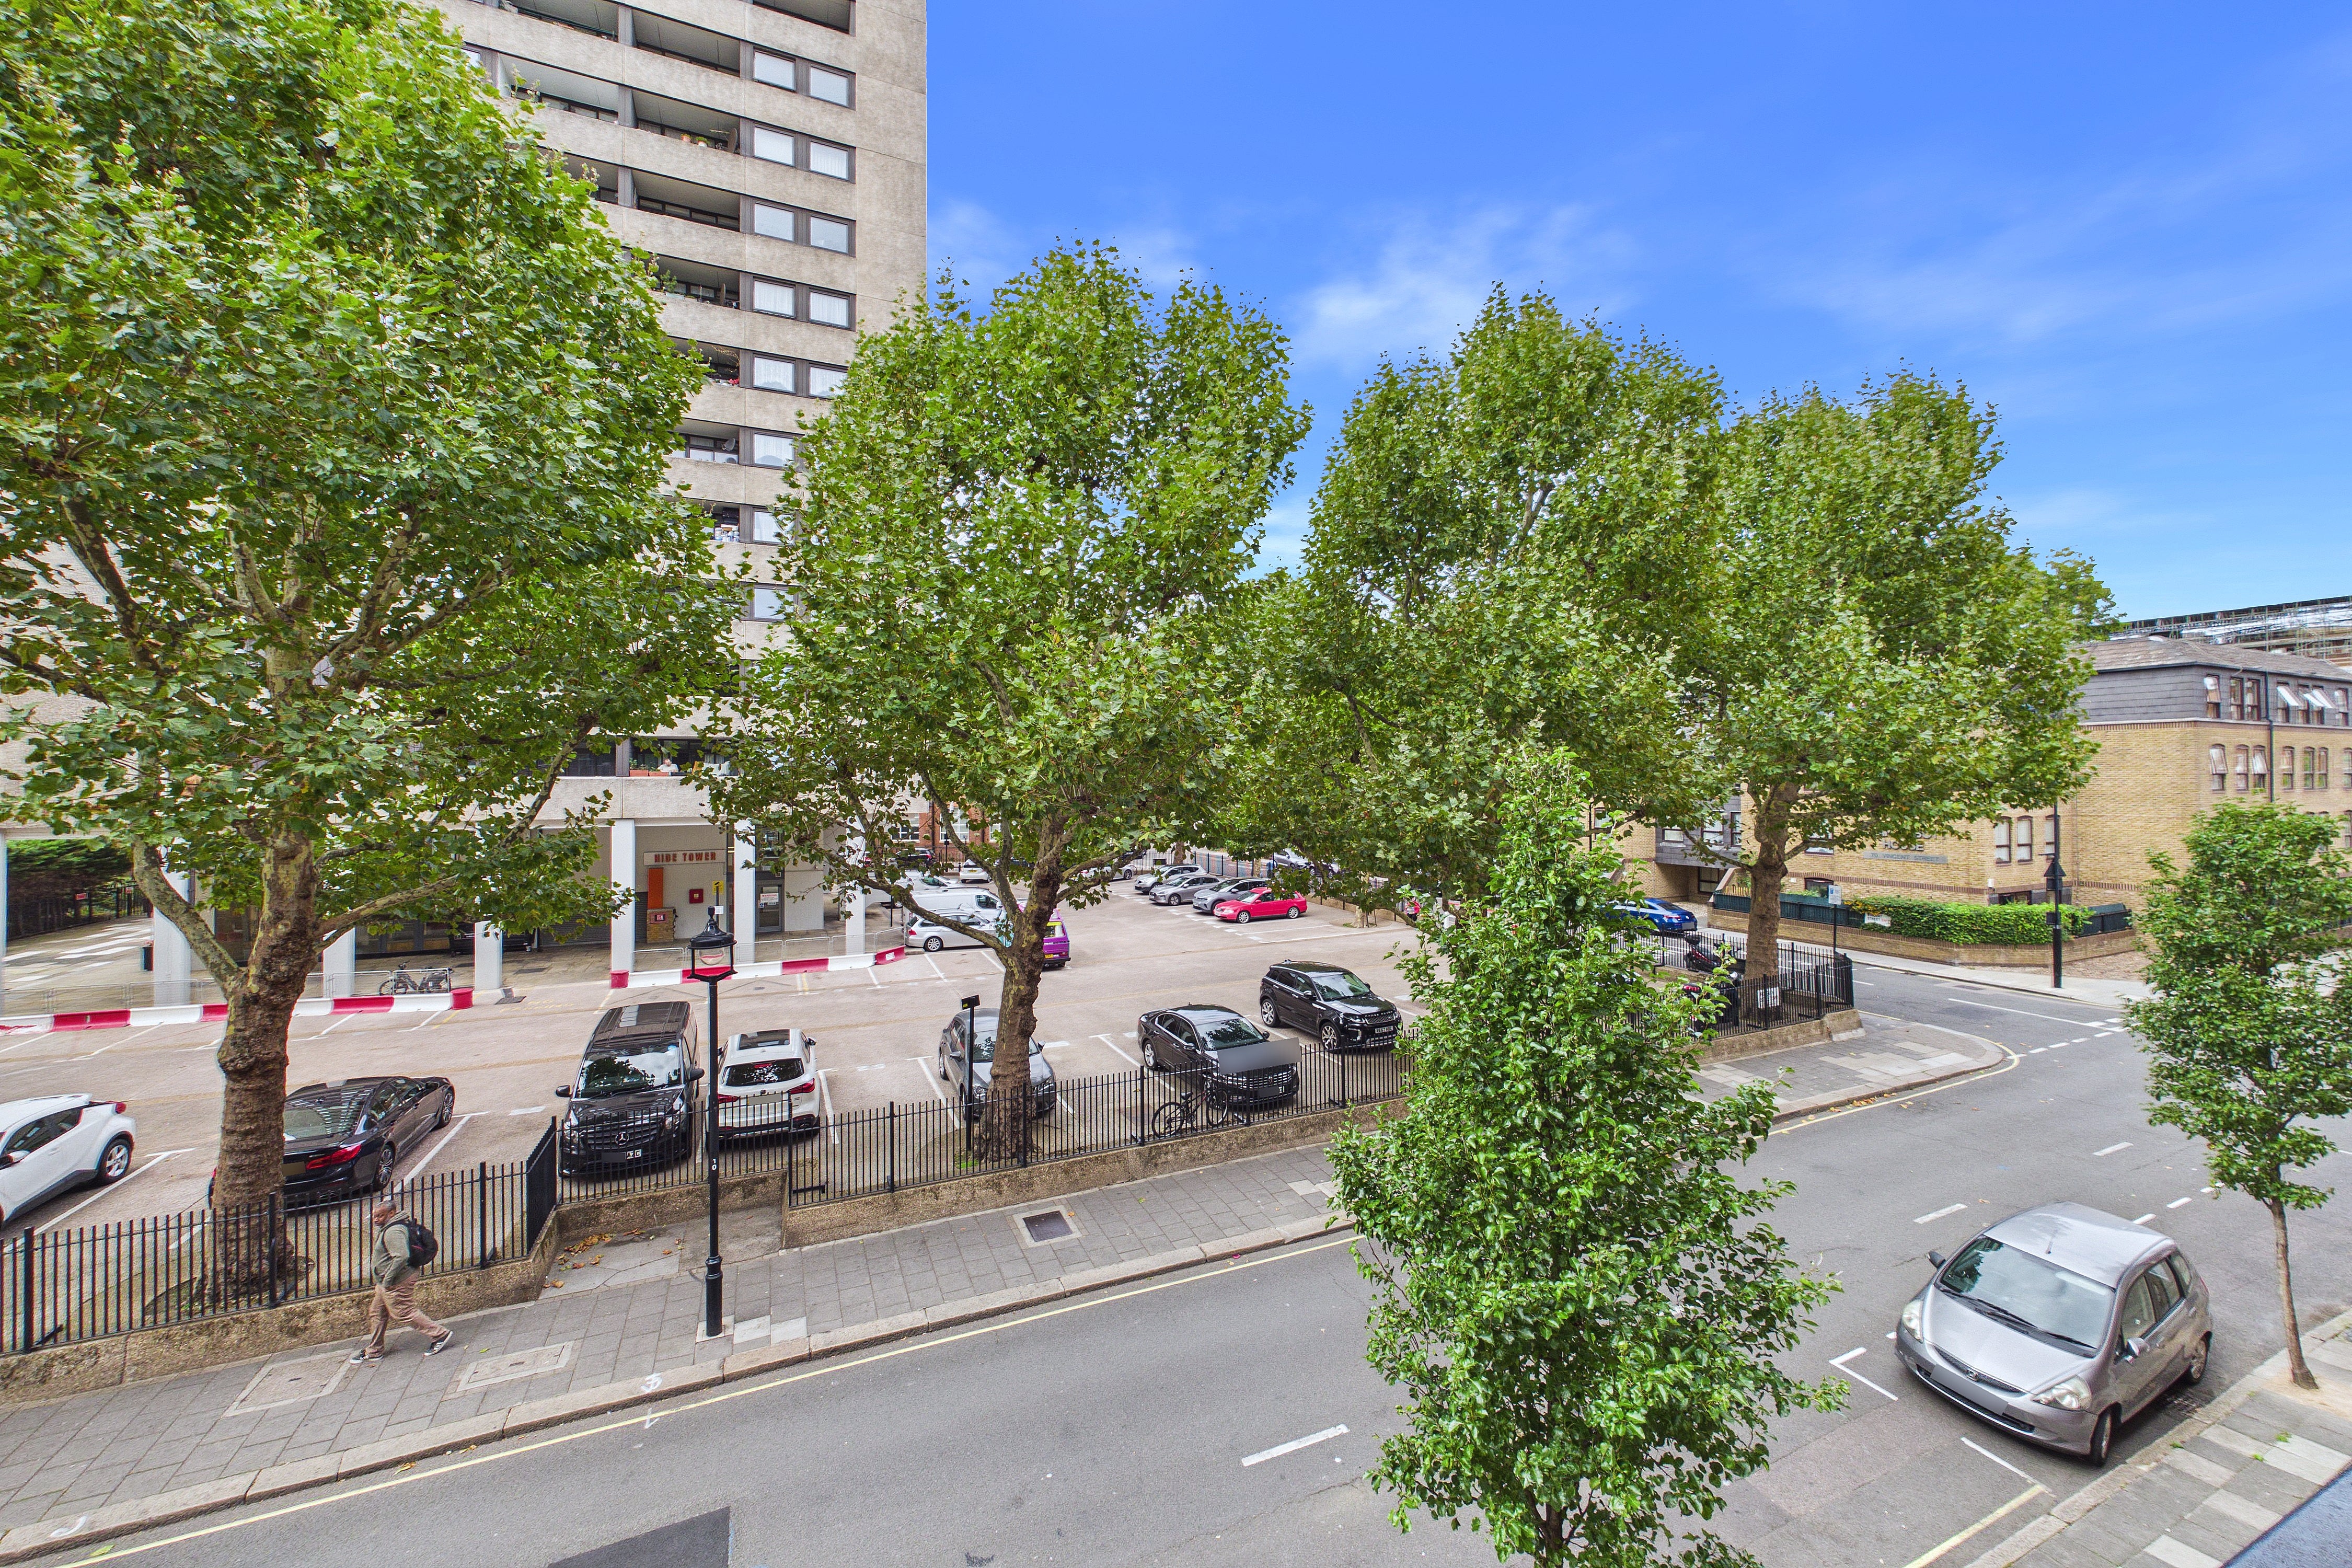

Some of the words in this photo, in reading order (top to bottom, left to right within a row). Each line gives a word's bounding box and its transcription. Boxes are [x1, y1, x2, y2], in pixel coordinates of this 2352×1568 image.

[654, 854, 677, 862] HIDE
[683, 852, 717, 861] TOWER
[712, 1158, 717, 1170] 10
